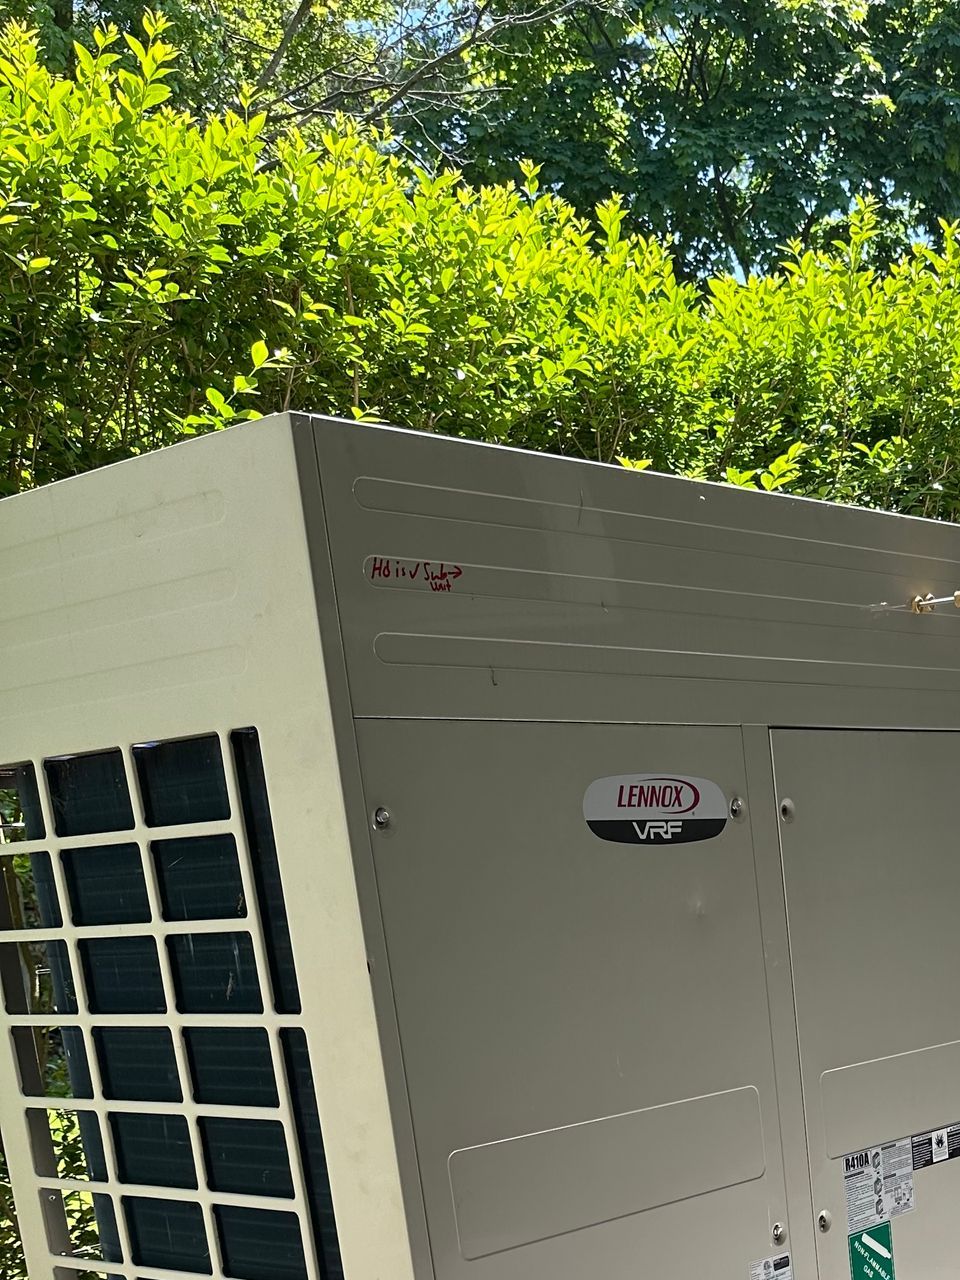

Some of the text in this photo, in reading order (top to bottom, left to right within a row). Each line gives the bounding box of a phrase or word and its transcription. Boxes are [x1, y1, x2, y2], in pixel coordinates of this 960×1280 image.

[617, 785, 684, 808] LENNOX
[632, 821, 683, 840] VRF
[845, 1152, 870, 1172] R410A
[863, 1265, 874, 1278] GAS
